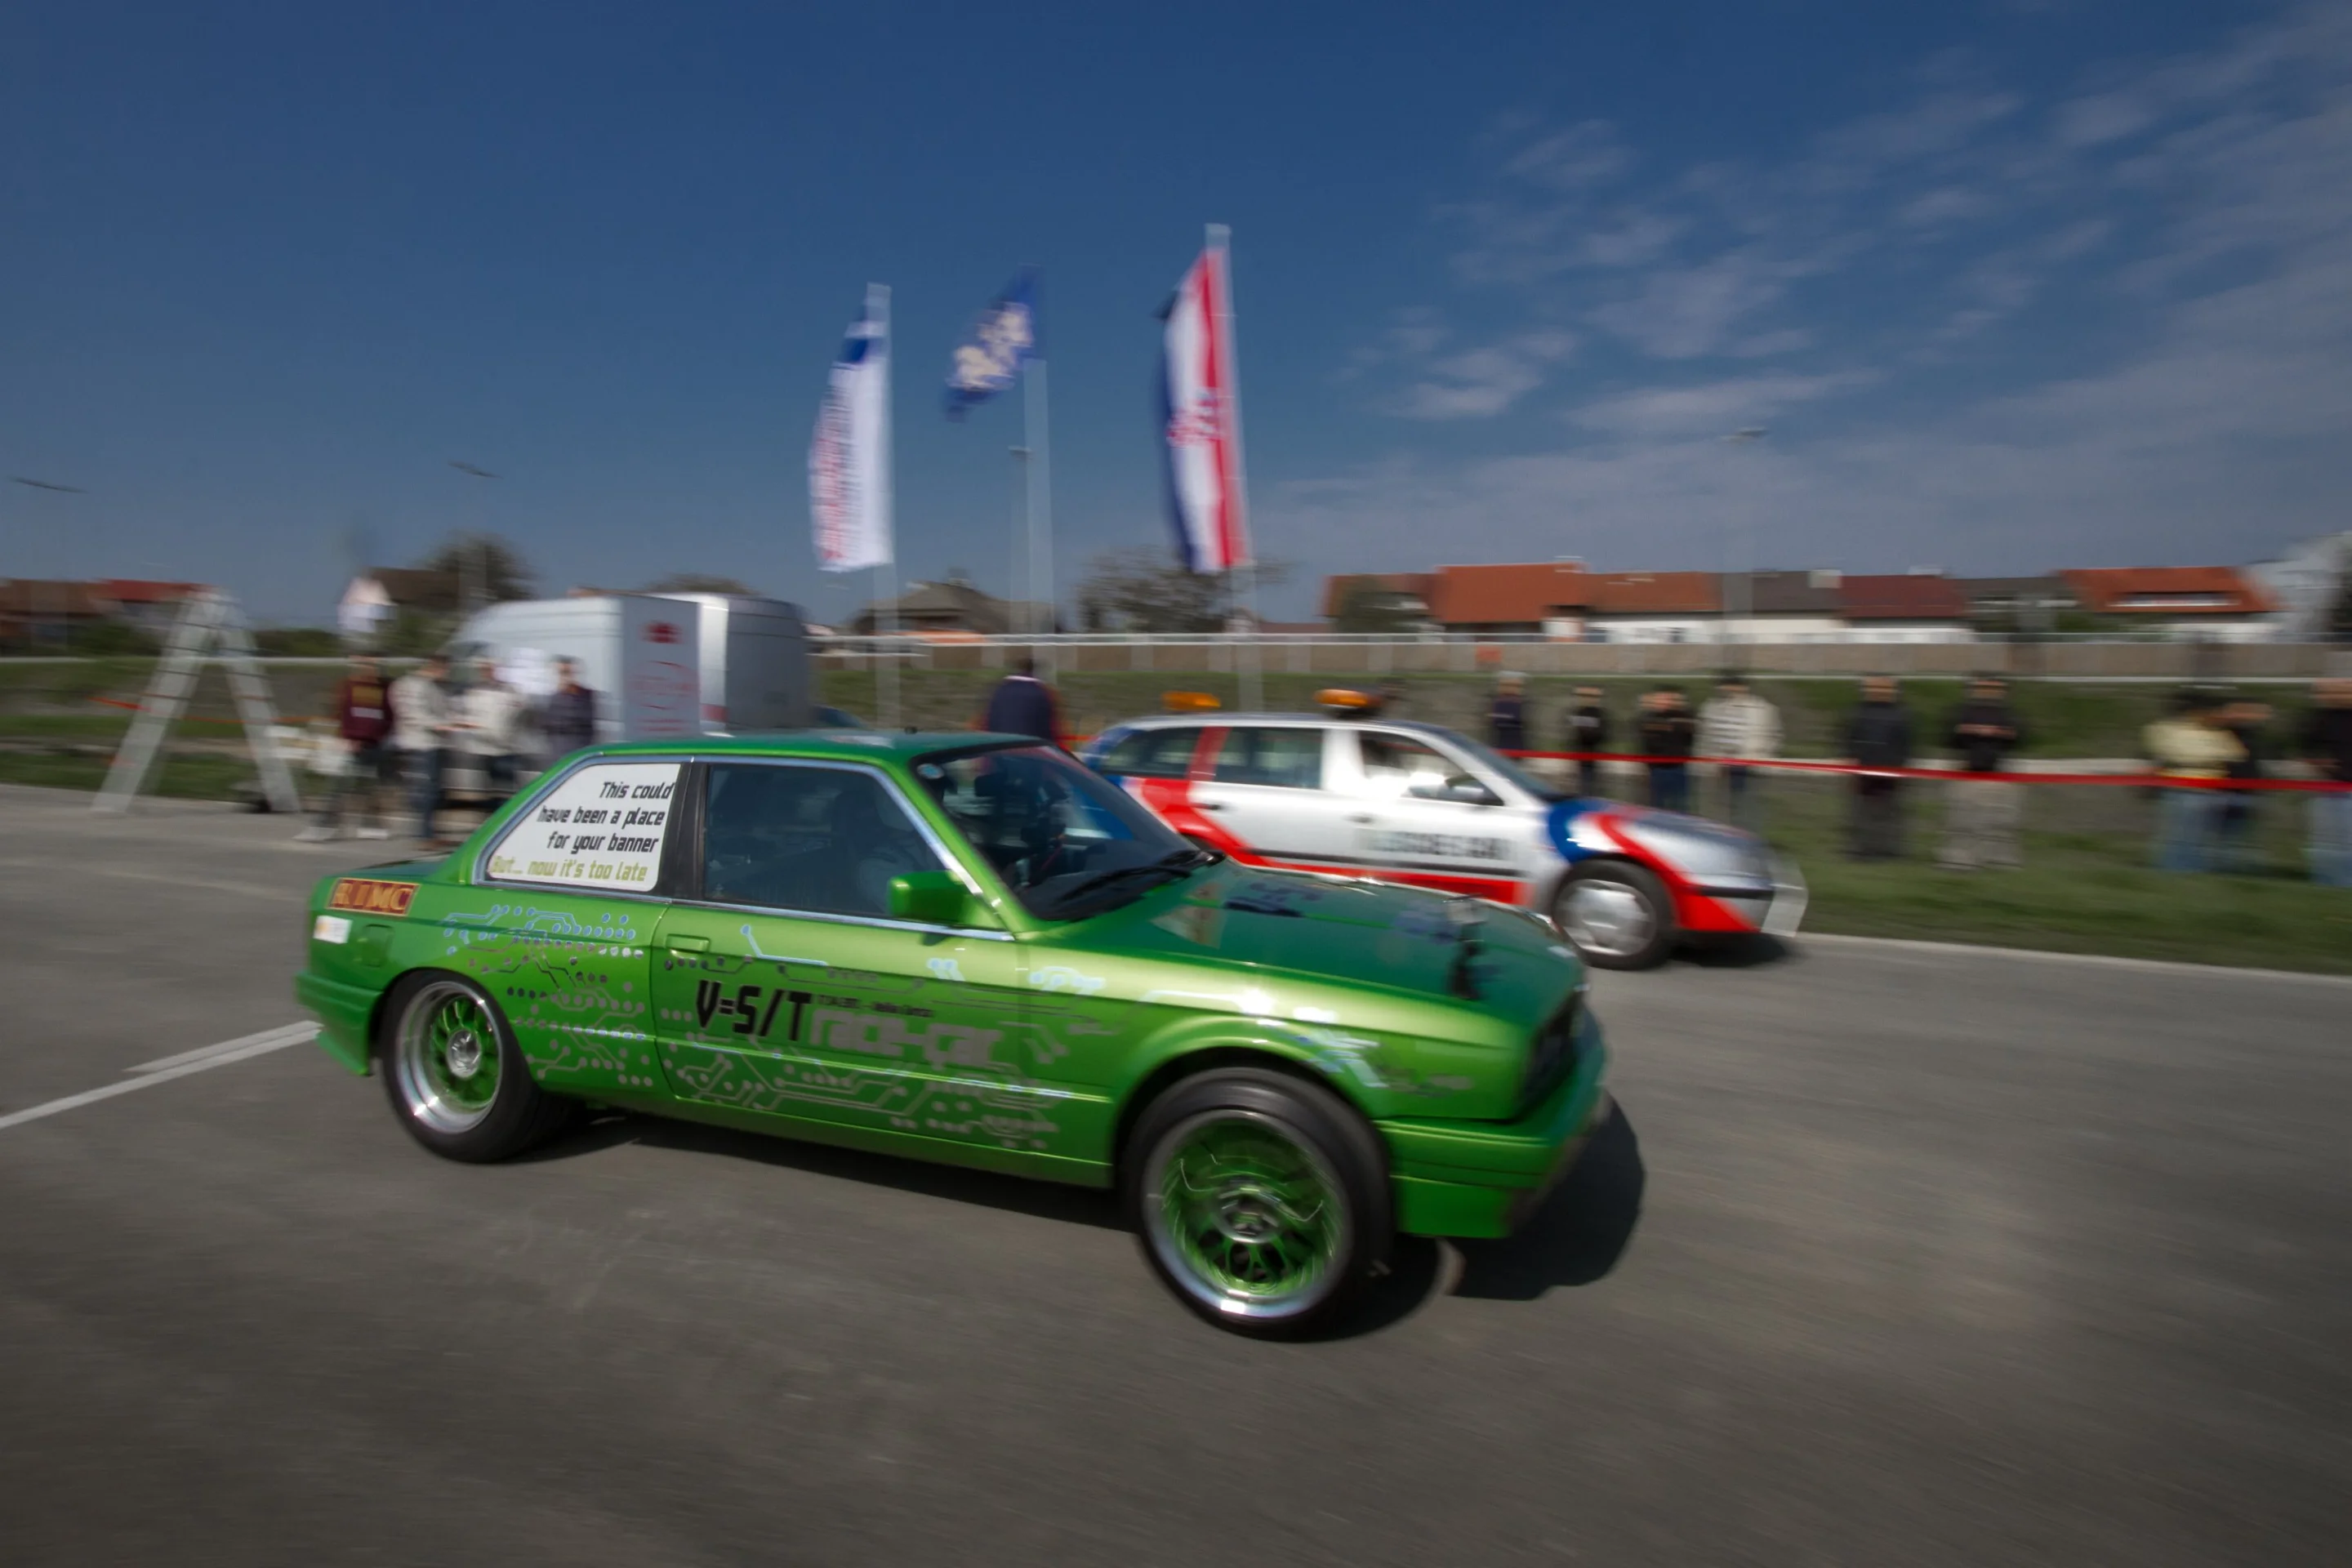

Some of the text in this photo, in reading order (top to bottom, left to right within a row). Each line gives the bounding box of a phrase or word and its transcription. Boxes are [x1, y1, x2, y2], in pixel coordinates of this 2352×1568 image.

[599, 782, 676, 800] This could
[537, 805, 666, 829] have been a place
[546, 831, 660, 854] for your banner
[527, 860, 559, 876] now
[559, 858, 583, 879] it's
[587, 861, 613, 880] too
[615, 862, 648, 882] late
